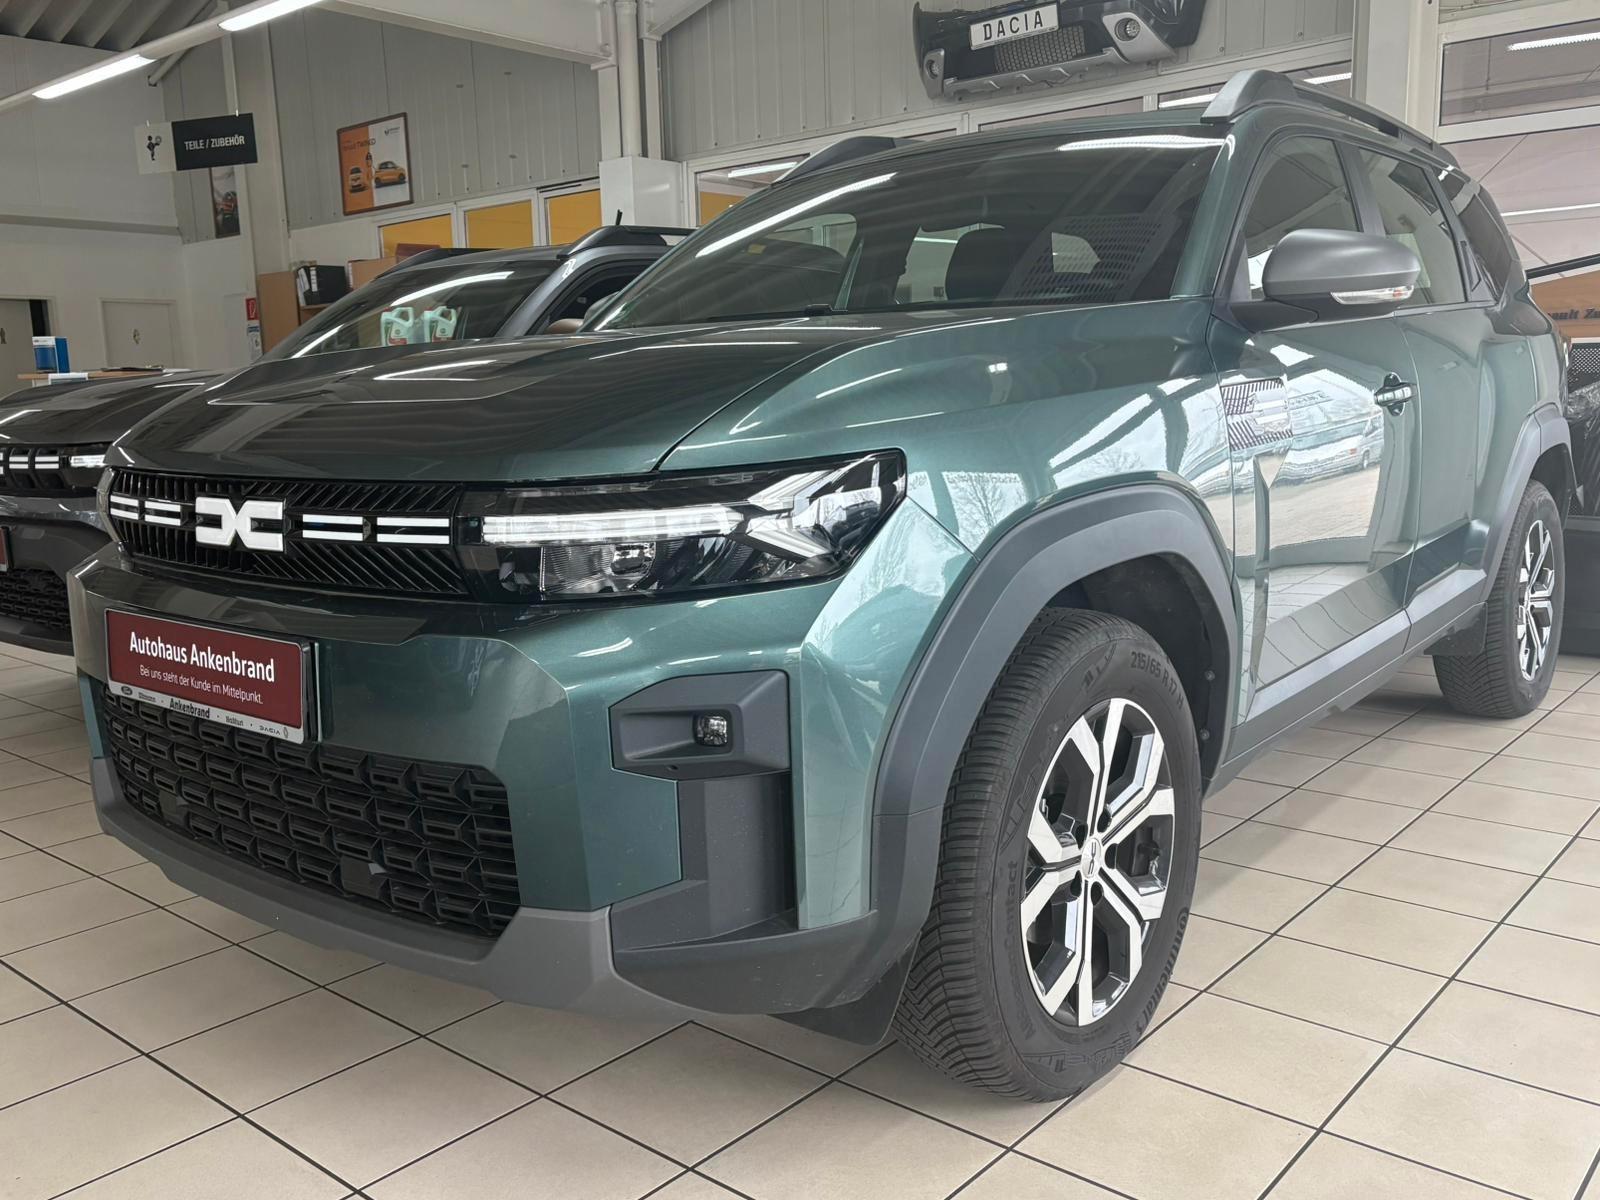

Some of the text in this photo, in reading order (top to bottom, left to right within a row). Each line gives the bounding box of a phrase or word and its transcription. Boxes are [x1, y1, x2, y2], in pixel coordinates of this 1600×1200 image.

[983, 11, 1043, 41] DACIA
[184, 139, 204, 150] TEILE
[210, 133, 245, 148] ZUBEHÖR
[129, 631, 275, 683] Autohaus Ankenbrand
[1130, 650, 1161, 678] 215/65
[140, 664, 263, 705] Bei uns steht der Kunde im Mittelpunkt.
[170, 698, 210, 719] Ankenbrand
[1141, 906, 1190, 1024] Continental
